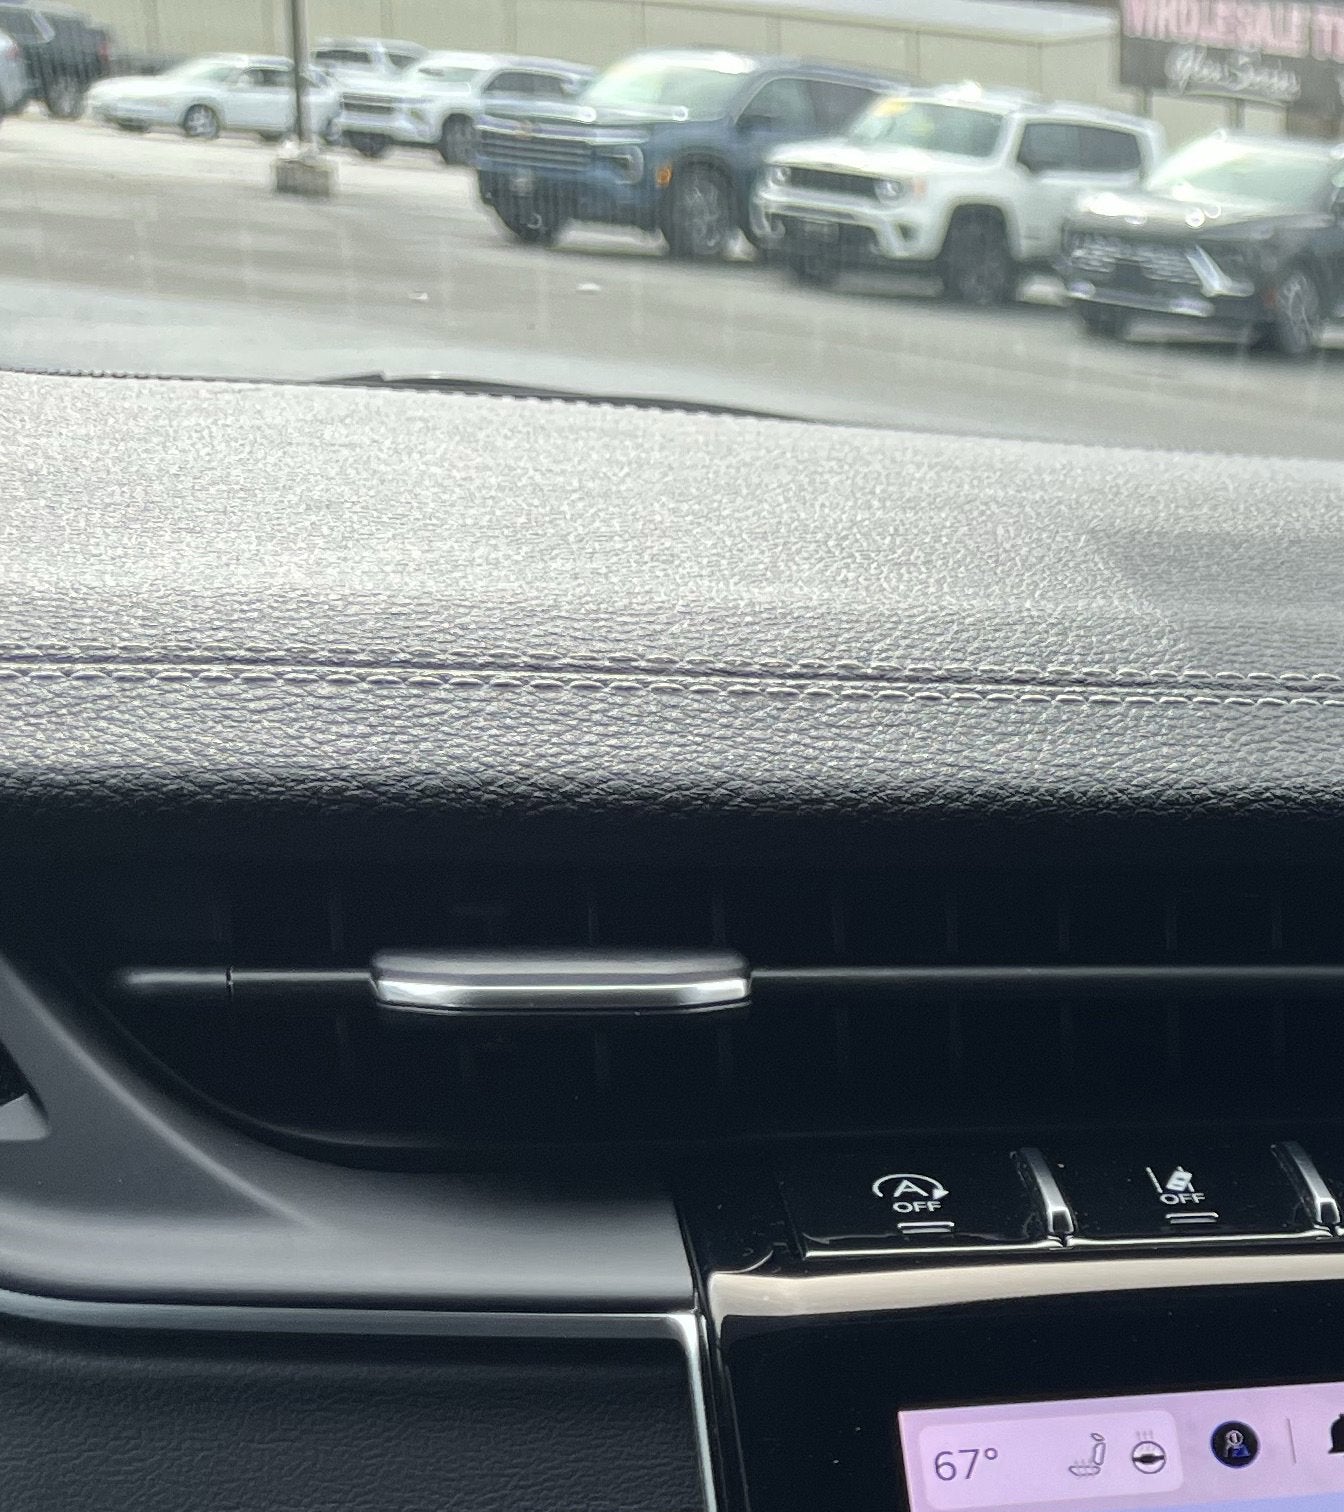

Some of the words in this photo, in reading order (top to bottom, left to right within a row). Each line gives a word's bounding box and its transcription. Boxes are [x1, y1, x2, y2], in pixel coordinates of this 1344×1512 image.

[1159, 1192, 1206, 1205] OFF
[892, 1200, 942, 1213] OFF
[933, 1447, 999, 1483] 67°
